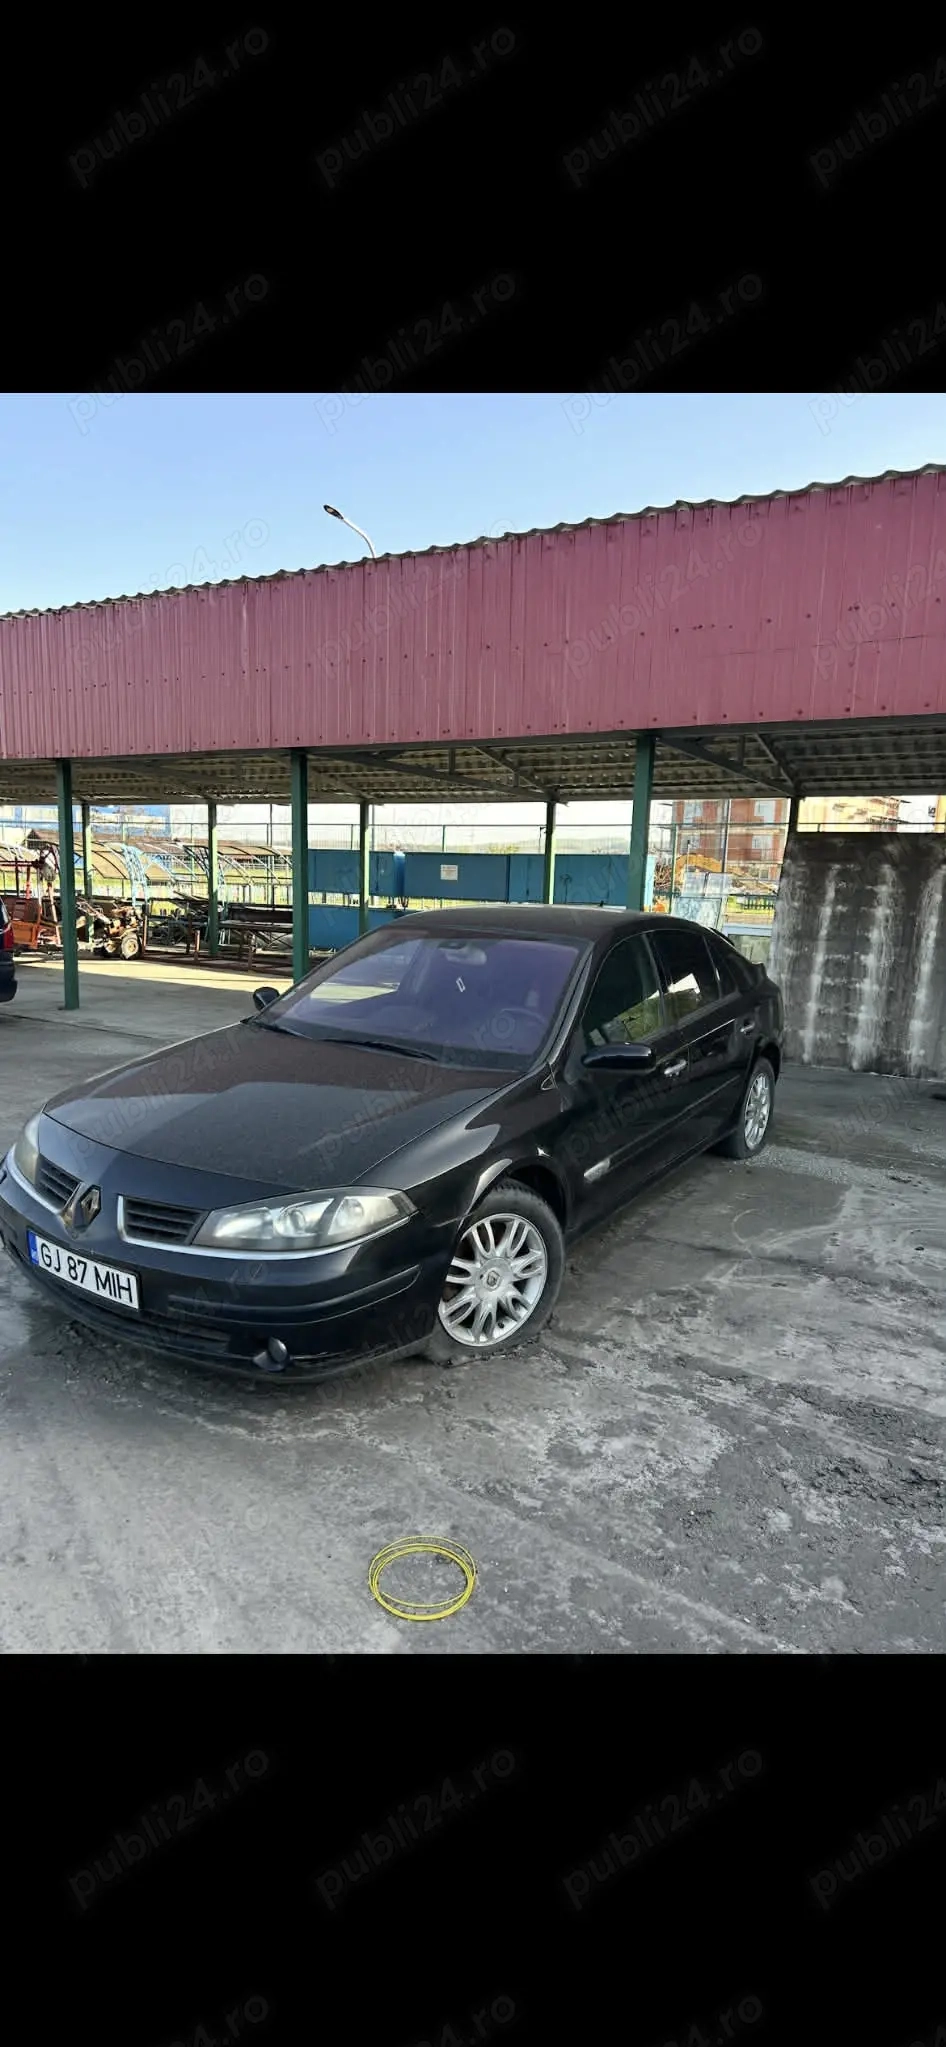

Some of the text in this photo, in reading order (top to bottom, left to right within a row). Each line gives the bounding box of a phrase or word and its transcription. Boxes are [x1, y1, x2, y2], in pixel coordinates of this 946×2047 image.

[40, 1243, 134, 1303] GJ 87 MIH
